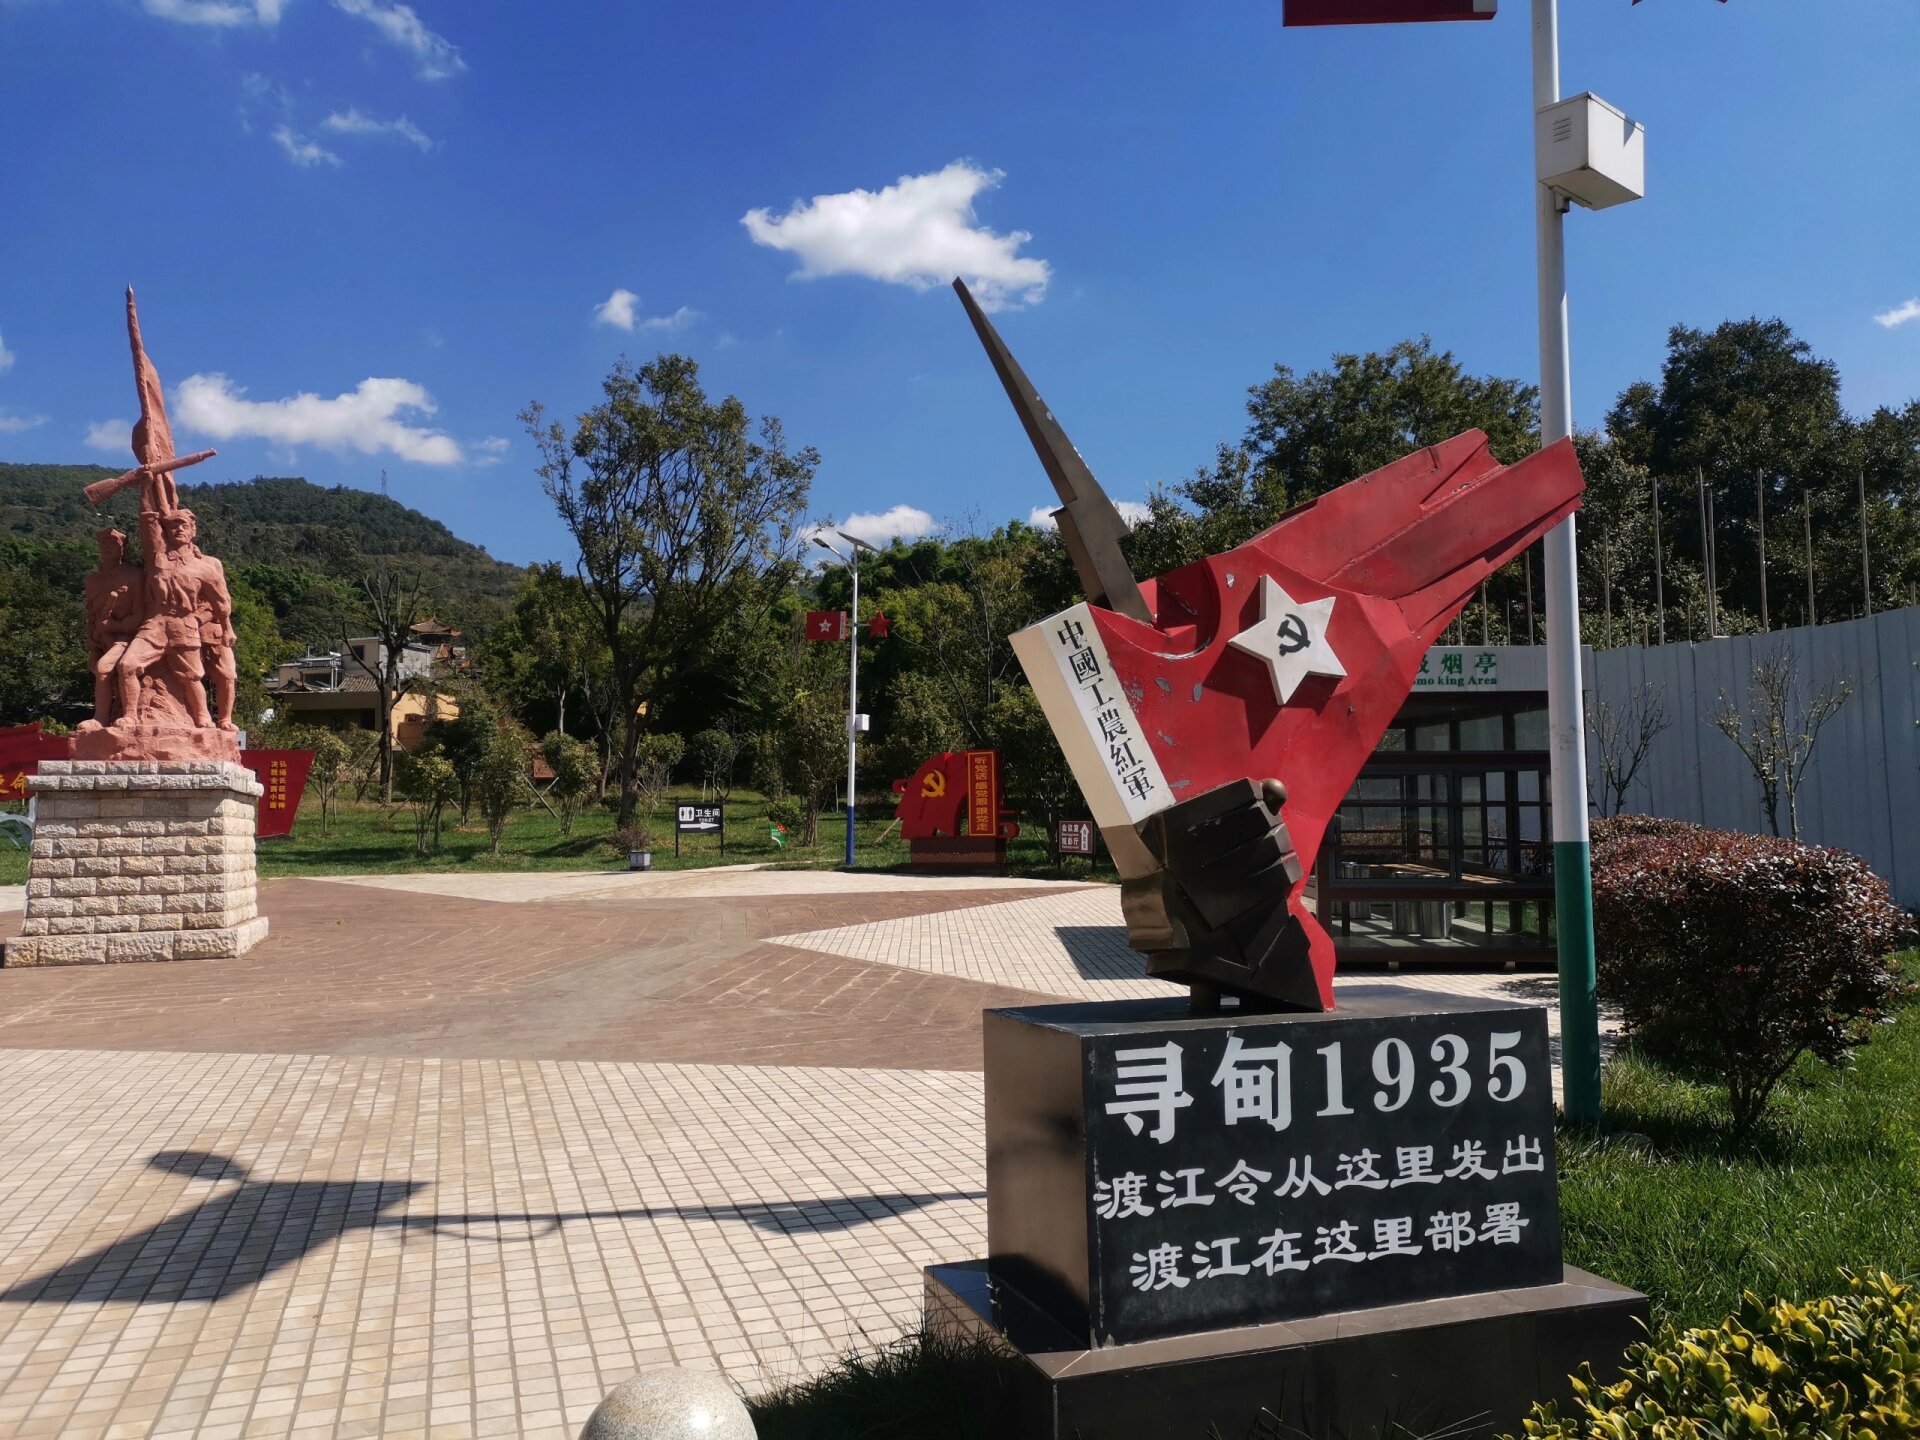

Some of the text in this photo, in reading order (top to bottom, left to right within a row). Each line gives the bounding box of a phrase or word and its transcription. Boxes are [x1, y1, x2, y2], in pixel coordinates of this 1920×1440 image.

[1056, 619, 1155, 801] 中國工農紅軍
[1467, 675, 1498, 686] Area
[695, 808, 720, 818] 卫生间
[1093, 1134, 1545, 1219] 渡江令从这里发出
[1129, 1202, 1530, 1291] 渡江在这里部署
